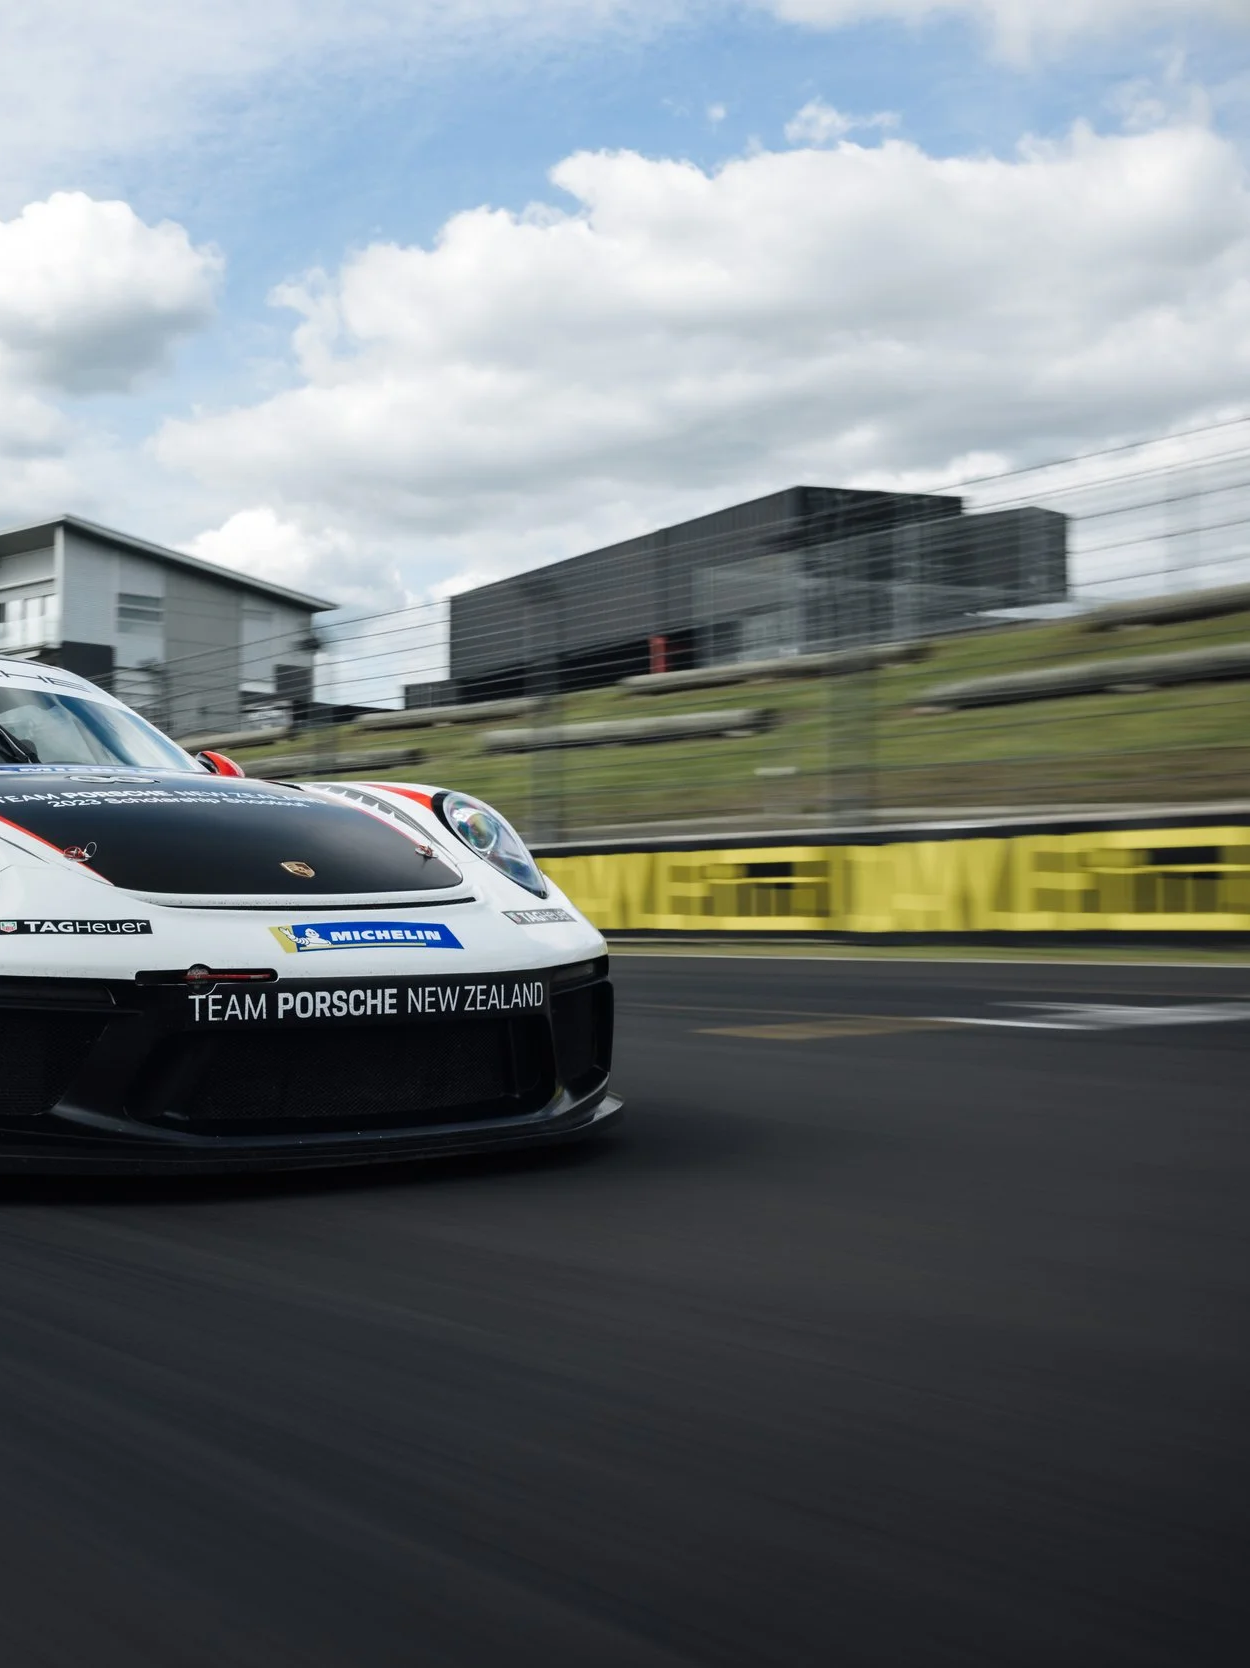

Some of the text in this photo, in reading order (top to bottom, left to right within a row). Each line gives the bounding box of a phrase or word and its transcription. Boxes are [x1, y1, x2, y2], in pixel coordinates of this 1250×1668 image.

[61, 790, 173, 799] PORSCHE
[47, 799, 102, 808] 2023
[330, 929, 442, 942] MICHELIN
[188, 981, 545, 1022] TEAM PORSCHE NEW ZEALAND
